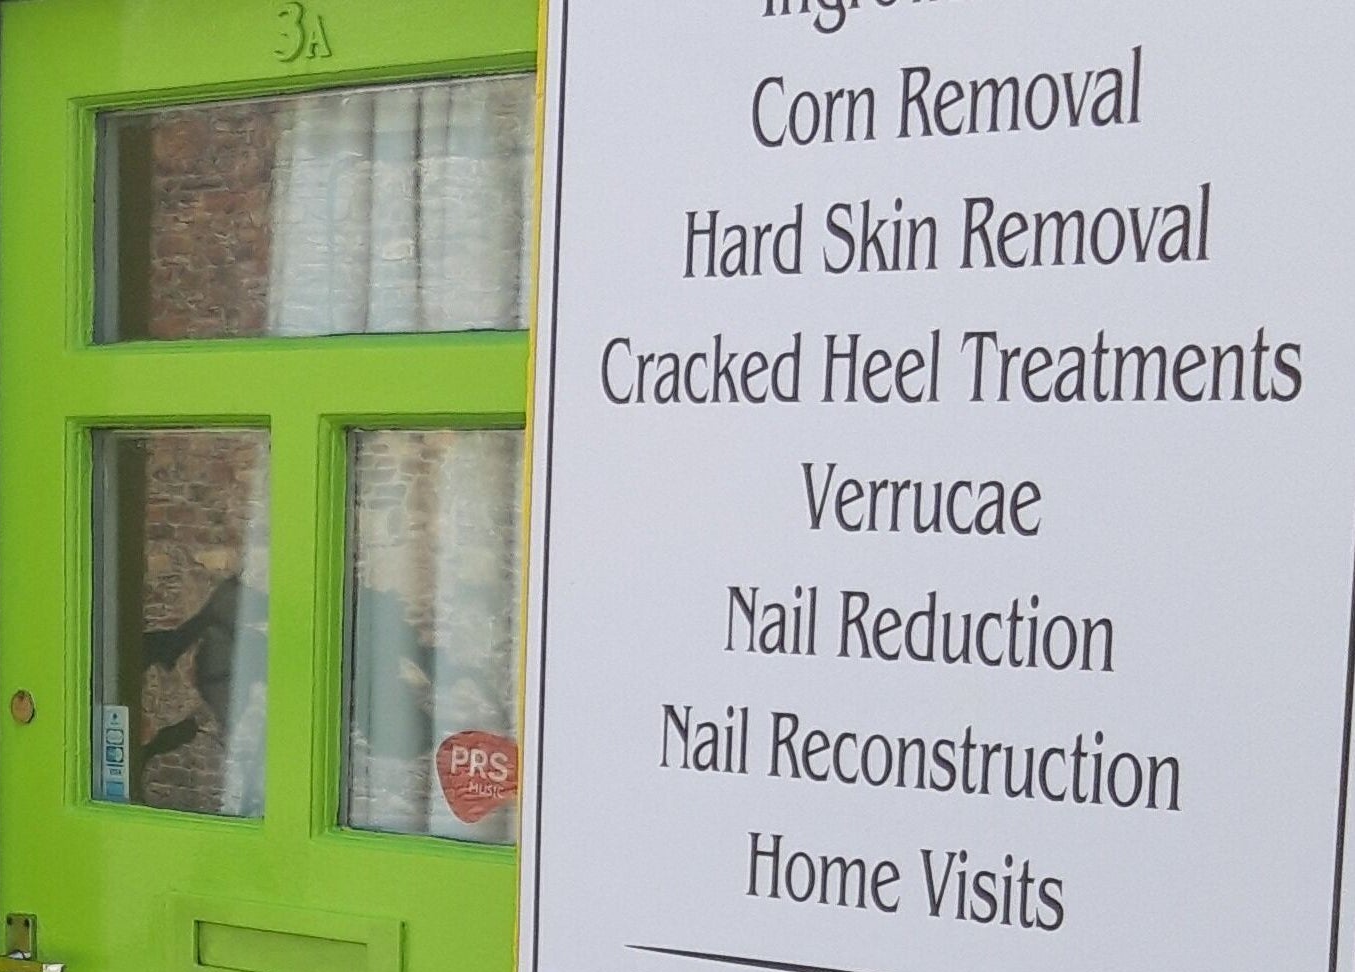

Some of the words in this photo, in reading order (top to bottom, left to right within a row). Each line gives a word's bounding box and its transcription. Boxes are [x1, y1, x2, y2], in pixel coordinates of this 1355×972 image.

[273, 1, 333, 63] 3A
[752, 76, 877, 148] Corn
[896, 45, 1143, 139] Removal
[682, 202, 804, 279] Hard
[822, 198, 938, 274] Skin
[959, 182, 1211, 270] Removal
[601, 332, 802, 405] Cracked
[820, 329, 941, 404] Heel
[960, 326, 1303, 403] Treatments
[800, 463, 1042, 537] Verrucae
[724, 586, 818, 656] Nail
[836, 591, 1115, 673] Reduction
[450, 745, 508, 783] PRS
[659, 704, 749, 775] Nail
[767, 712, 1181, 812] Reconstruction
[746, 832, 901, 913] Home
[919, 849, 1065, 932] Visits
